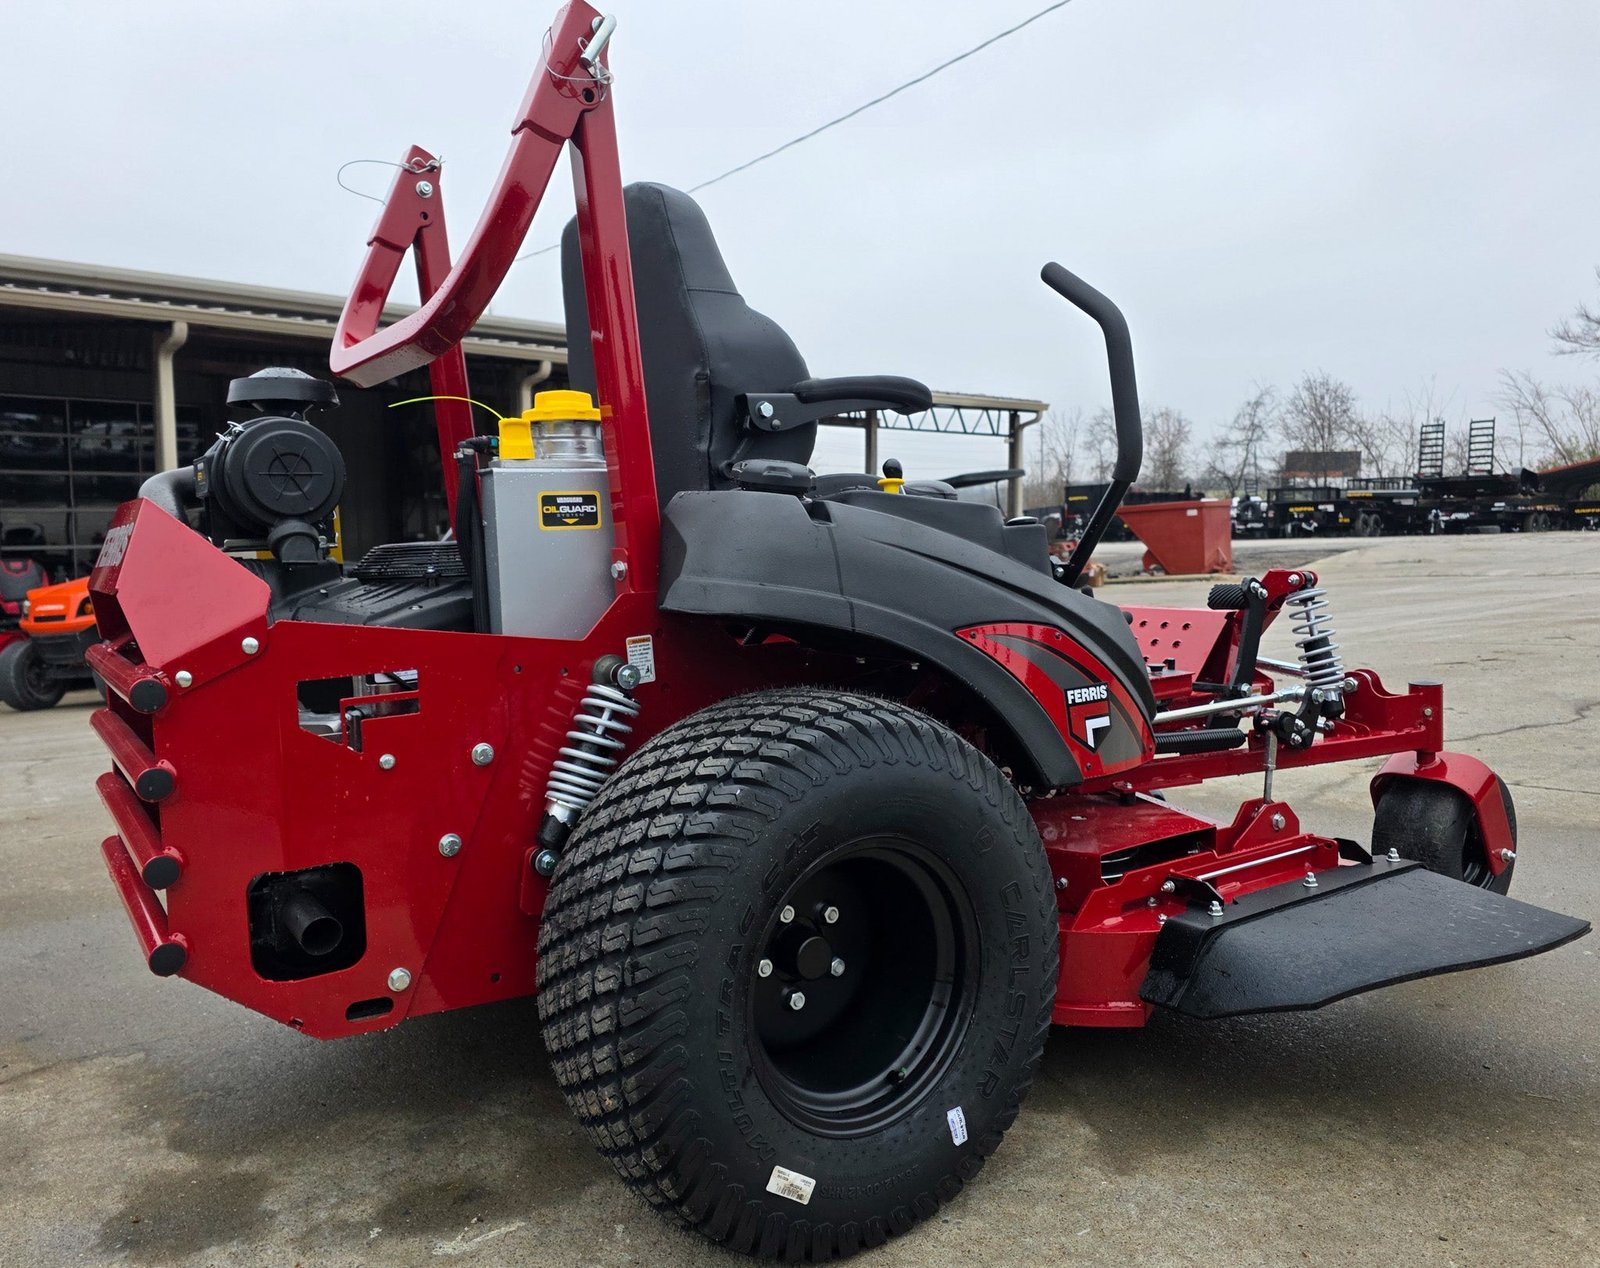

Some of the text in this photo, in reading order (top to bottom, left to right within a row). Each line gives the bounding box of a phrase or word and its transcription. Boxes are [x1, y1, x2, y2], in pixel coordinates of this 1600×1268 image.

[543, 505, 597, 514] OILGUARD
[1066, 685, 1108, 704] FERRIS
[977, 880, 1031, 1100] CARLSTAR
[716, 1048, 777, 1161] MULTI
